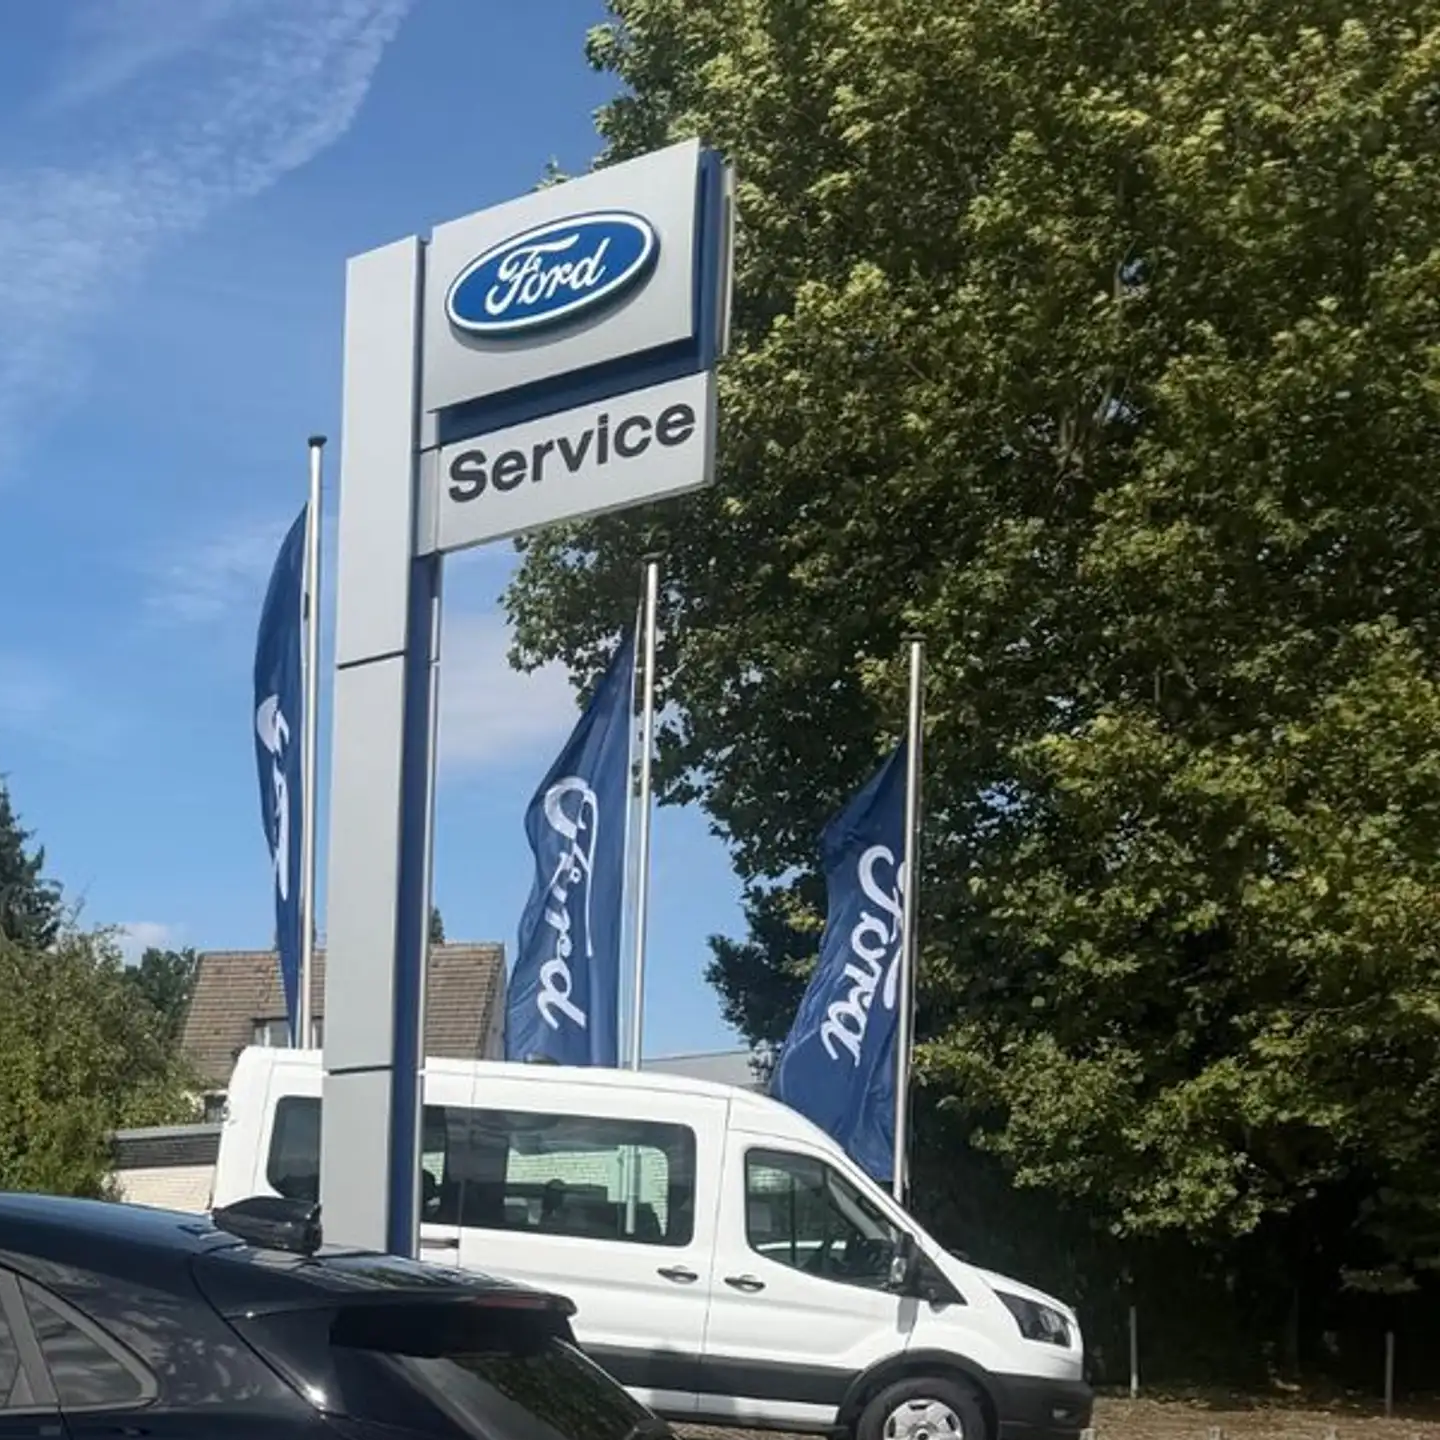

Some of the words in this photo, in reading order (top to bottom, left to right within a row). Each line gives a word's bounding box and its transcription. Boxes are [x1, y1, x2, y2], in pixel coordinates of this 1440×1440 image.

[485, 233, 611, 316] Ford
[448, 403, 697, 504] Service
[820, 845, 906, 1068] Ford
